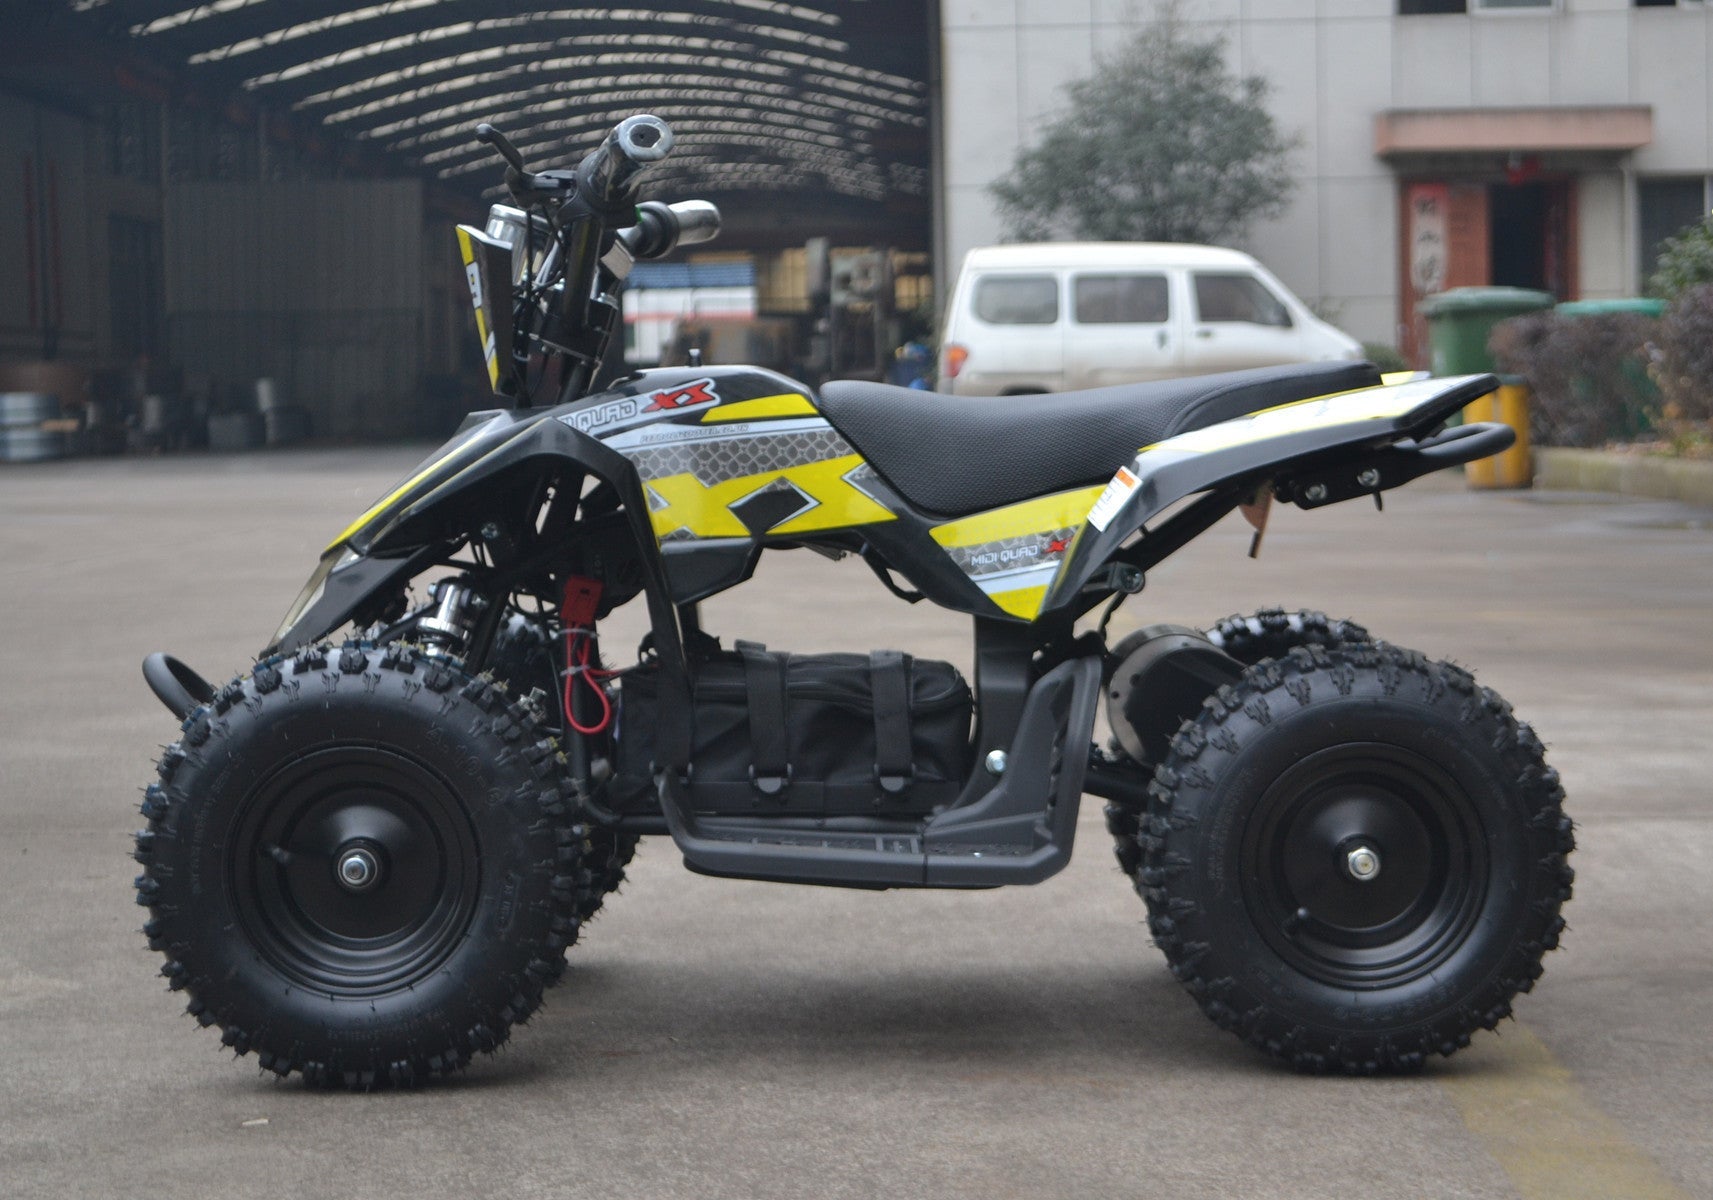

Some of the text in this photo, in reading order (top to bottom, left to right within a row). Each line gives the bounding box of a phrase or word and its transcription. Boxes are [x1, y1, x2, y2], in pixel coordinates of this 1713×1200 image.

[576, 399, 637, 433] QUAD
[971, 551, 997, 566] MIDI
[1000, 544, 1039, 562] QUAD
